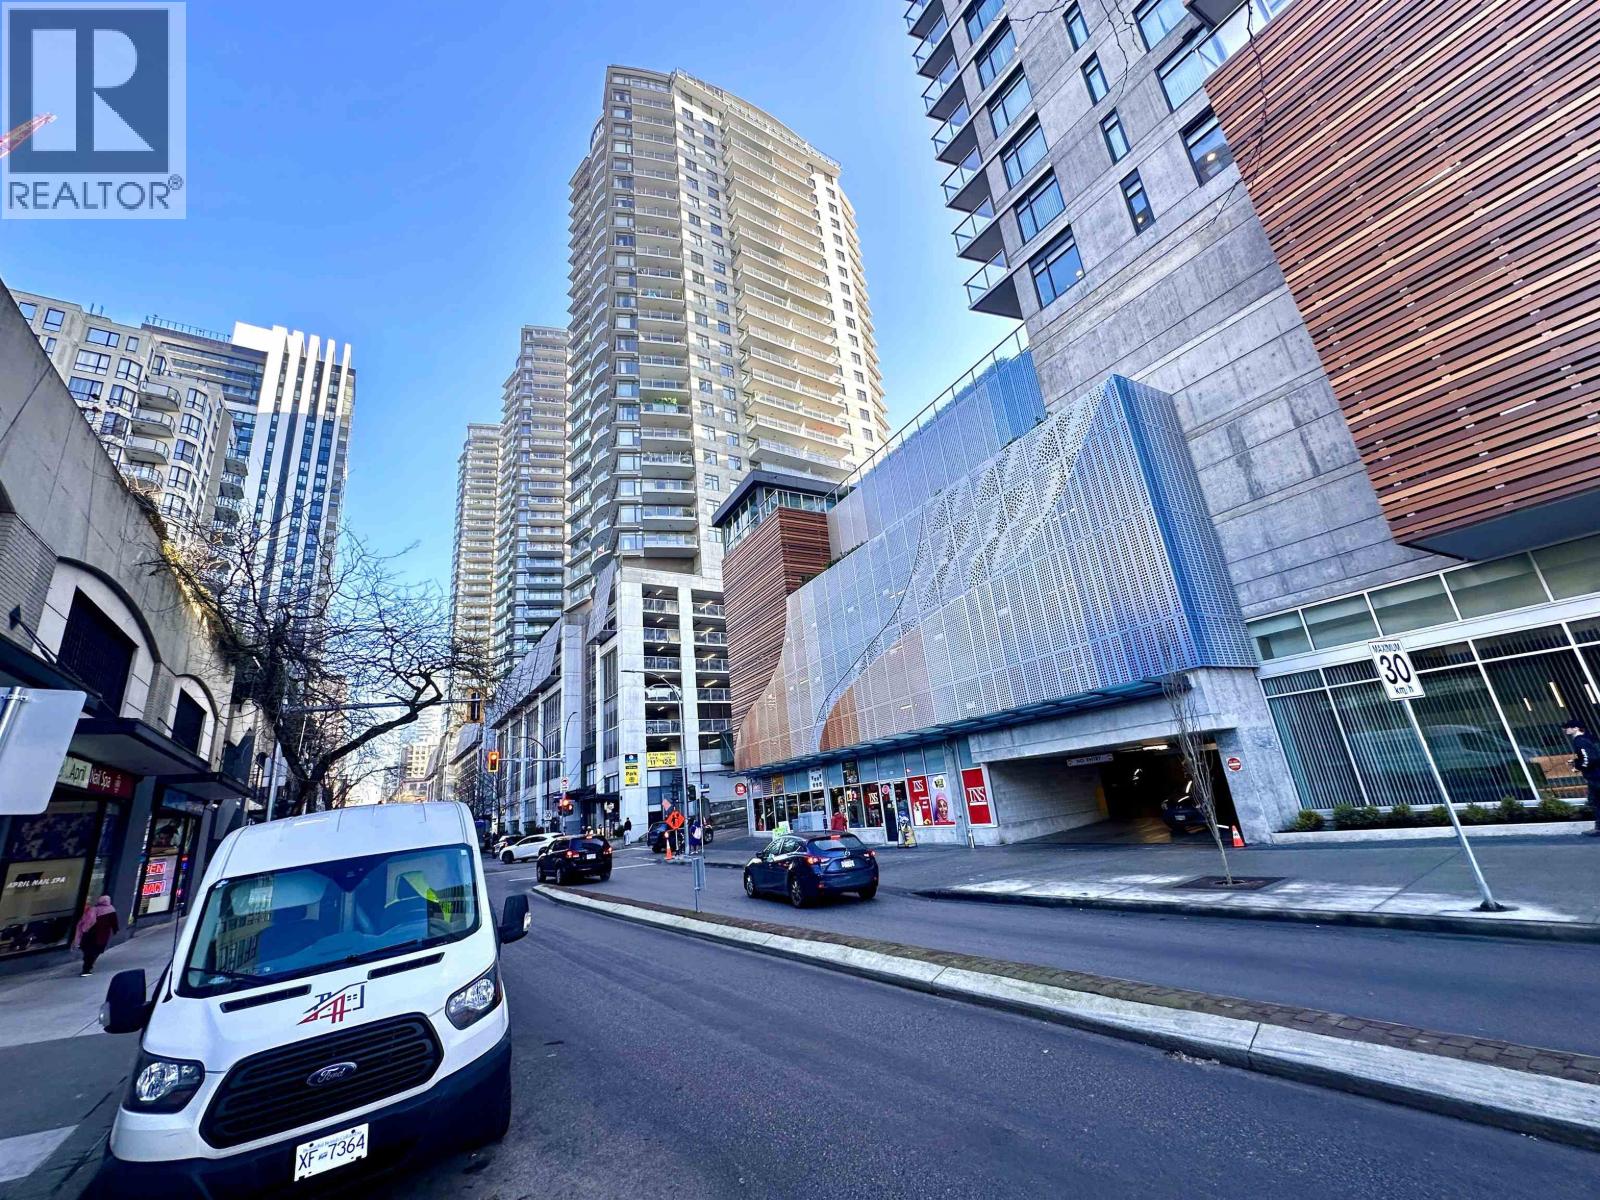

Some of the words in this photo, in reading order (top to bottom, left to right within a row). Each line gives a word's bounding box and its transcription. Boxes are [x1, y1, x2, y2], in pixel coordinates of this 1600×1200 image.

[1372, 643, 1401, 653] MAXIMUM
[1379, 653, 1411, 685] 30
[1394, 685, 1414, 695] km/h
[6, 880, 30, 889] APRIL
[31, 878, 50, 887] NAIL
[50, 876, 67, 884] SPA
[317, 1067, 347, 1084] Ford
[298, 1148, 318, 1171] XF
[328, 1133, 365, 1160] 7364
